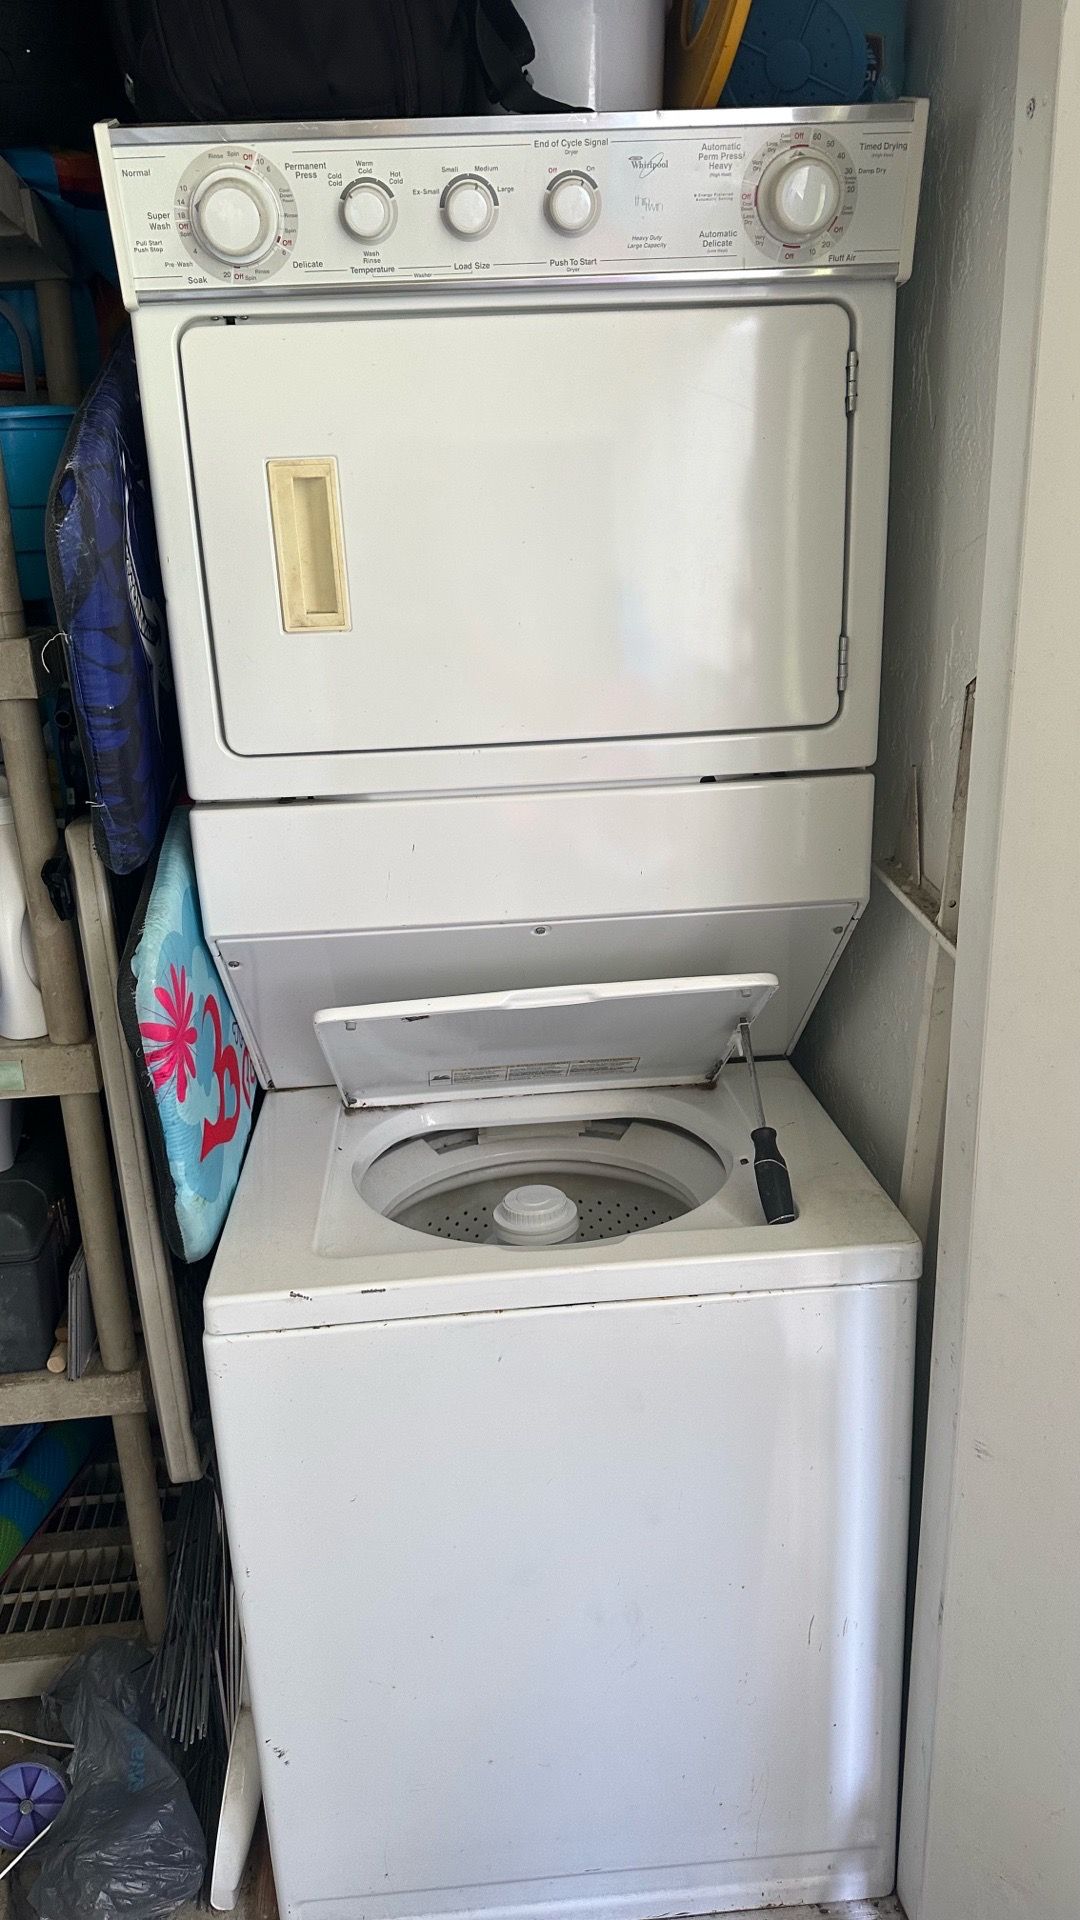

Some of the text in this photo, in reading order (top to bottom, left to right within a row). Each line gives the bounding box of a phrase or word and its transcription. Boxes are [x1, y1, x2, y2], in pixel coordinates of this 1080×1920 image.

[812, 133, 822, 141] 60
[534, 138, 609, 149] End of Cycle Signal
[701, 142, 741, 151] Automatic
[860, 141, 908, 152] Timed Drying
[242, 153, 253, 161] Off
[698, 153, 719, 161] Perm
[836, 152, 846, 160] 40
[284, 162, 327, 171] Permanent
[631, 160, 669, 170] Whirlpool
[708, 162, 733, 171] Heavy
[121, 169, 151, 178] Normal
[295, 171, 318, 179] Press
[497, 185, 515, 194] Large
[146, 211, 171, 221] Super
[149, 222, 171, 231] Wash
[178, 222, 189, 230] Off
[649, 234, 663, 242] Duty
[699, 230, 738, 239] Automatic
[148, 239, 163, 247] Start
[282, 239, 293, 247] Off
[702, 239, 733, 248] Delicate
[149, 246, 164, 254] Stop
[784, 252, 794, 260] Off
[828, 254, 856, 262] Fluff Air
[164, 261, 194, 269] Pre-Wash
[292, 260, 324, 269] Delicate
[453, 262, 491, 271] Load Size
[549, 257, 597, 267] Push To Start
[223, 271, 232, 279] 20
[350, 266, 396, 276] Temperature
[187, 276, 208, 285] Soak
[233, 272, 244, 280] Off
